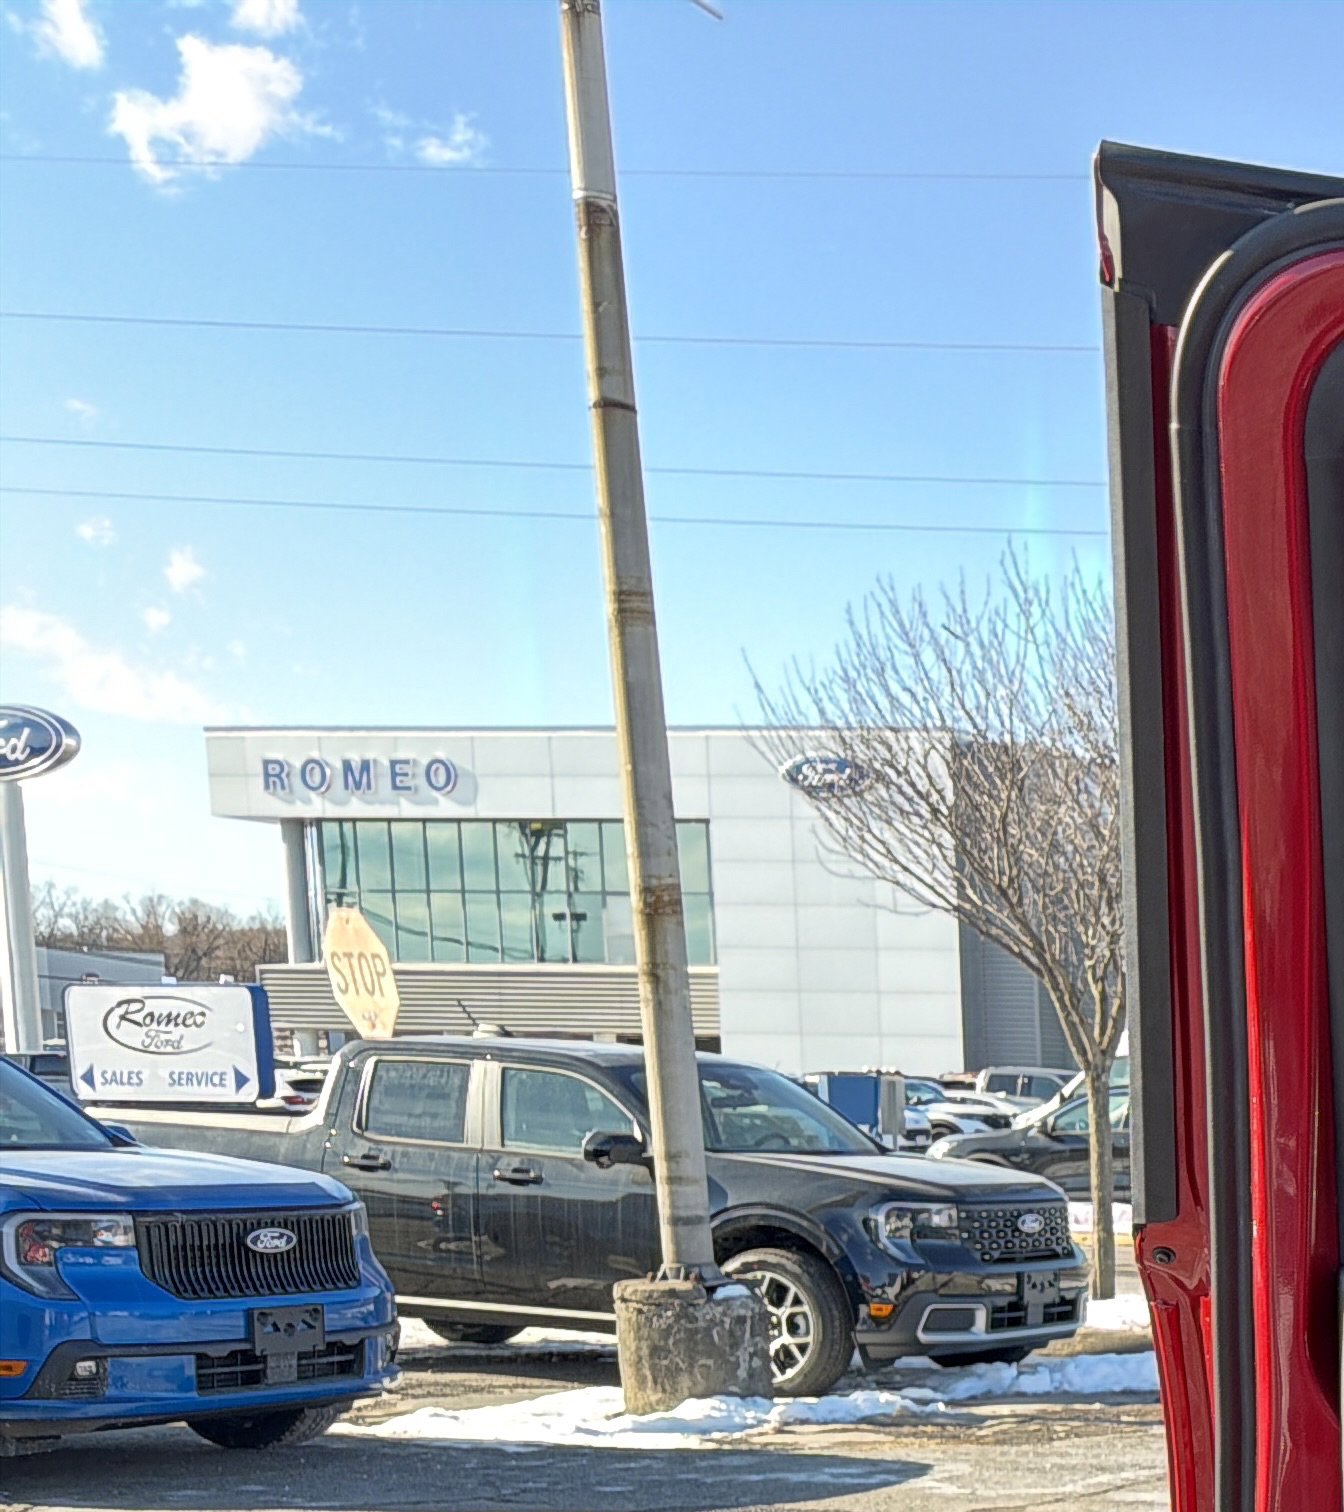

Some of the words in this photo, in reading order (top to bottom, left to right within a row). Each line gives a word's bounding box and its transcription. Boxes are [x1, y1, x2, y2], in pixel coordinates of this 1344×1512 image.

[262, 757, 458, 795] ROMEO
[330, 951, 386, 998] STOP
[141, 1029, 184, 1050] Ford
[100, 1069, 144, 1087] SALES
[168, 1070, 227, 1088] SERVICE
[257, 1231, 288, 1248] Ford
